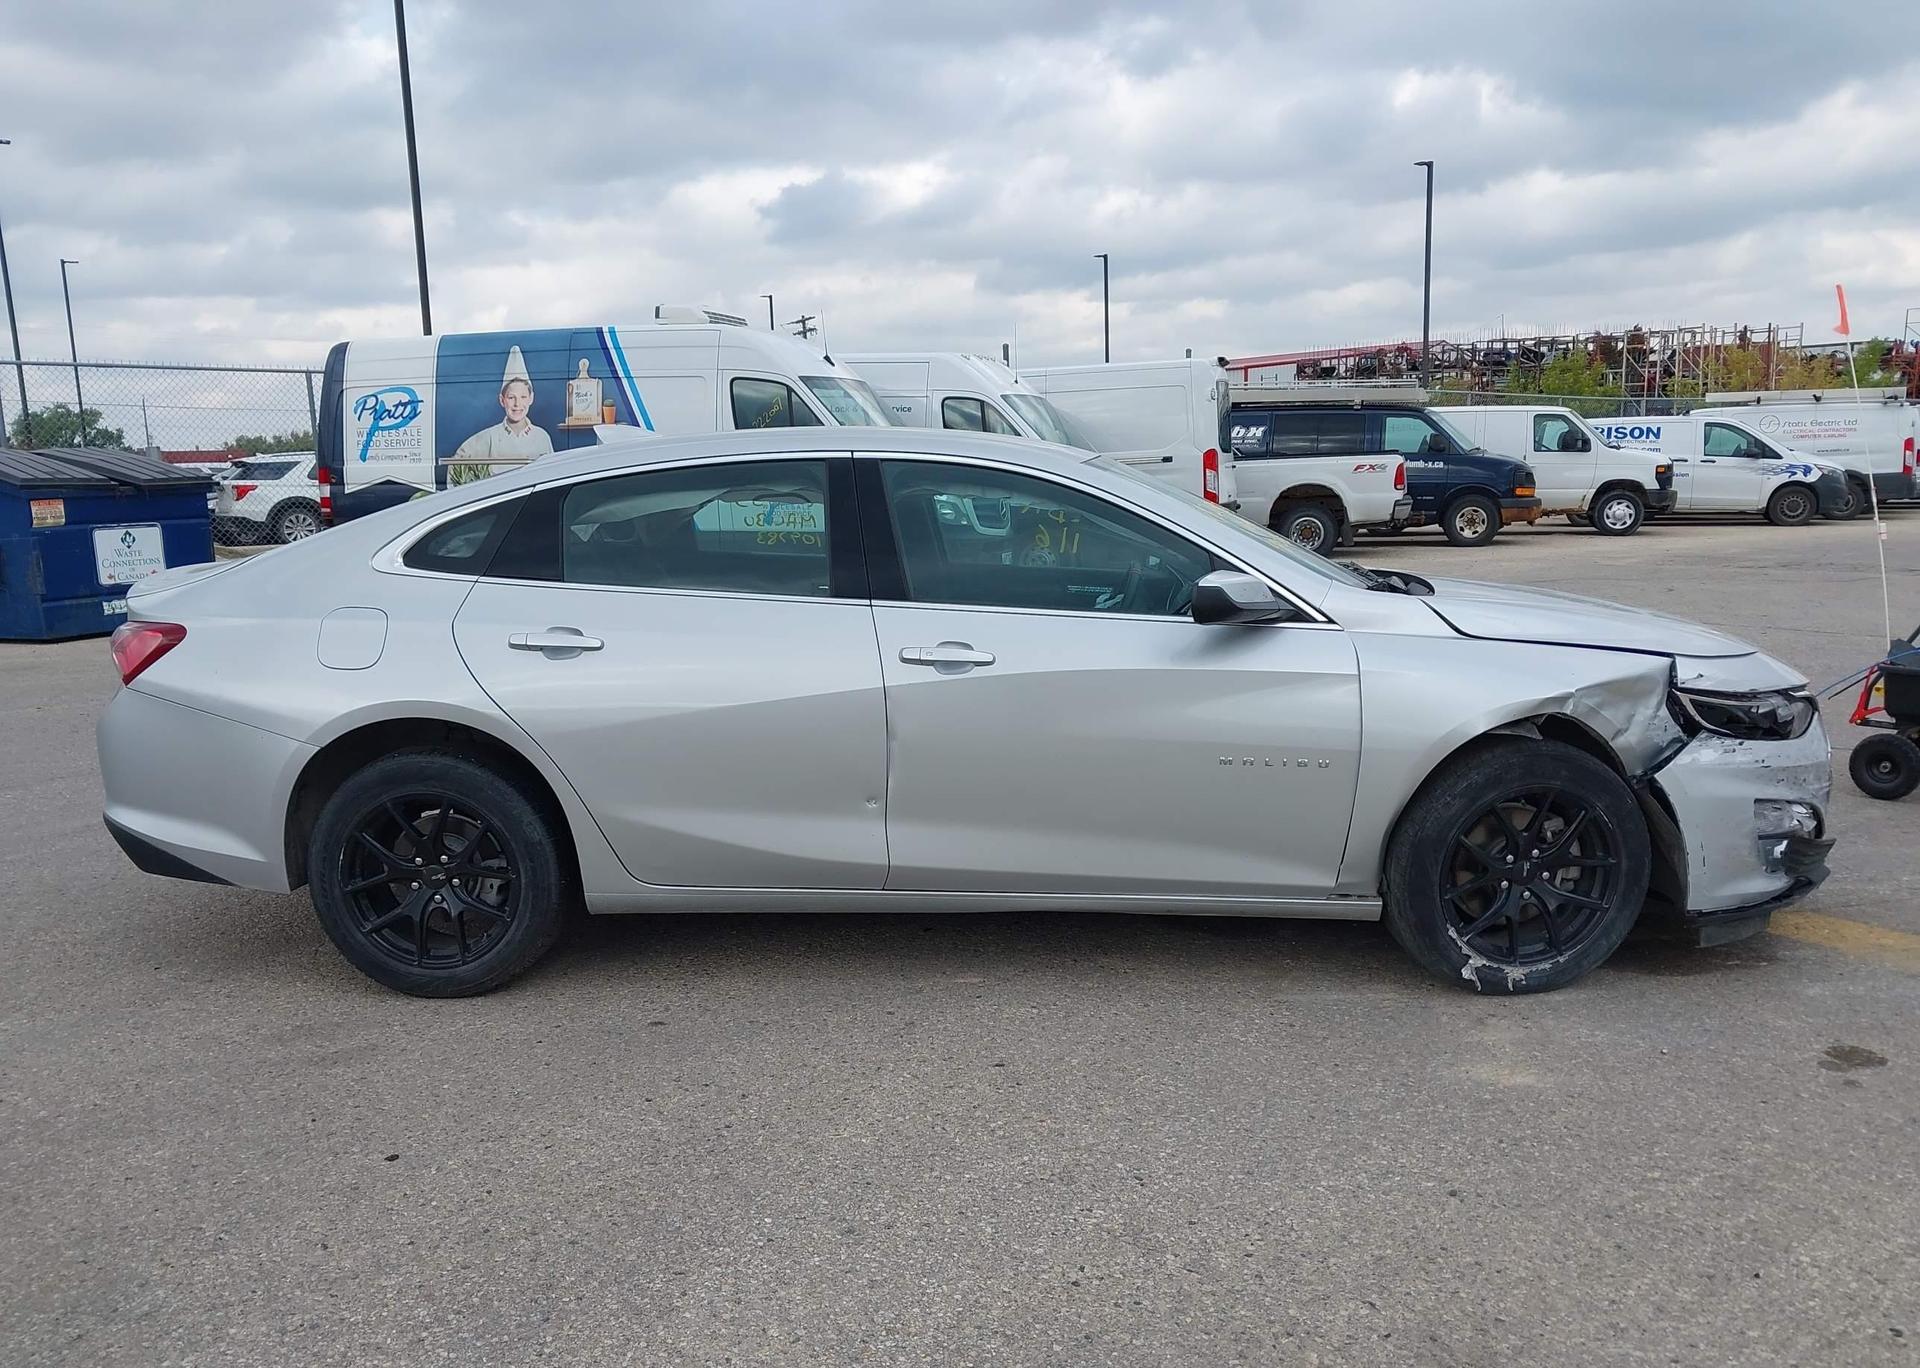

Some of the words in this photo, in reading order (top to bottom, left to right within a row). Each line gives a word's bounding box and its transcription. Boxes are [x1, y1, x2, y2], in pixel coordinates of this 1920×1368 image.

[355, 393, 424, 422] Pratts
[891, 405, 912, 413] rvice
[1782, 420, 1808, 428] Static
[1810, 419, 1841, 427] Electric
[384, 439, 422, 448] SERVICE
[1406, 460, 1444, 468] lumb-x.ca
[101, 556, 161, 569] CONNECTIONS
[1219, 757, 1330, 768] MALIBU
